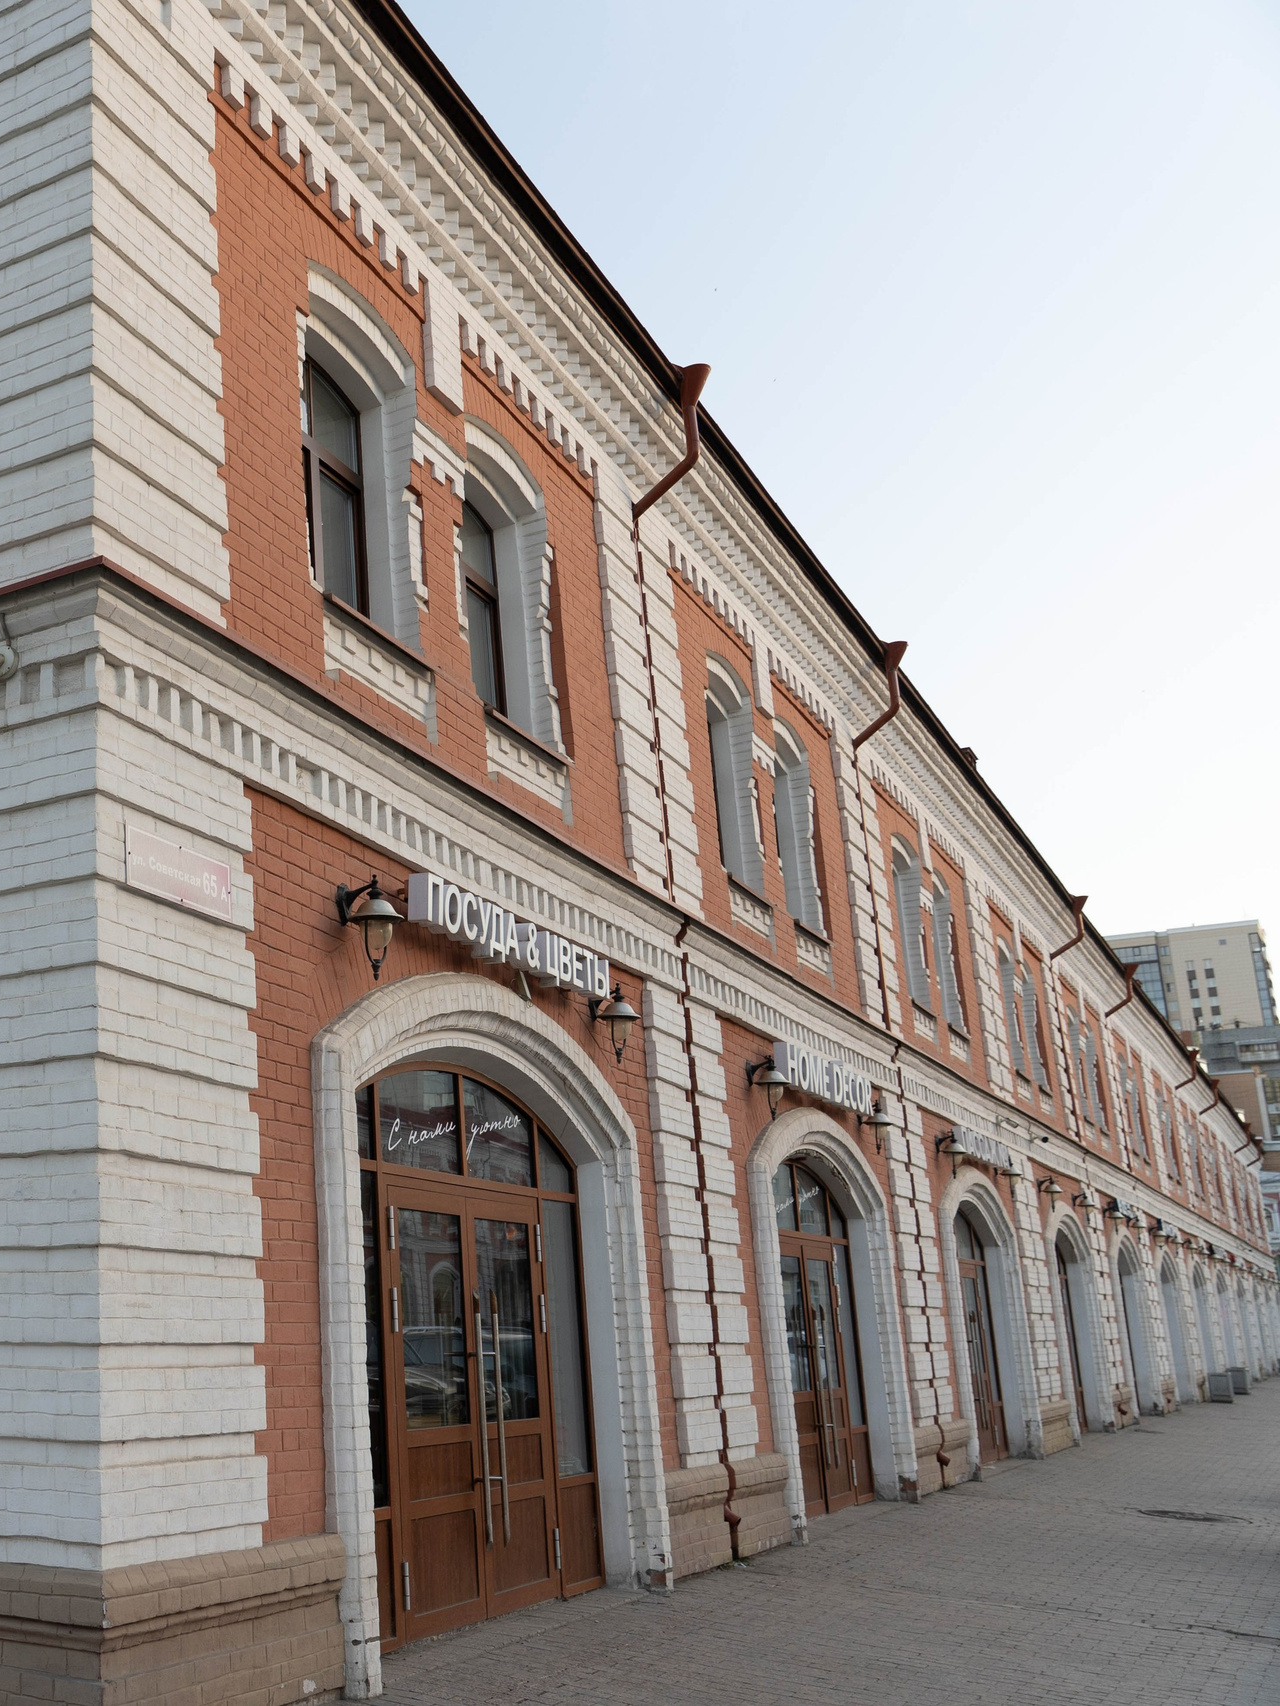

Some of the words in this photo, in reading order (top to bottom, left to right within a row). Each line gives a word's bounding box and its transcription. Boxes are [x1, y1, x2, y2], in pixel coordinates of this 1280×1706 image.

[131, 853, 146, 867] ул.
[148, 856, 201, 888] Советская
[202, 871, 218, 898] 65
[426, 872, 521, 963] ПОСУДА
[526, 922, 541, 970] &
[544, 930, 611, 999] ЦВЕТЫ
[786, 1041, 831, 1100] HOME
[832, 1062, 874, 1117] DECOR
[387, 1117, 402, 1151] С
[407, 1120, 456, 1145] нами
[465, 1114, 522, 1160] уютно
